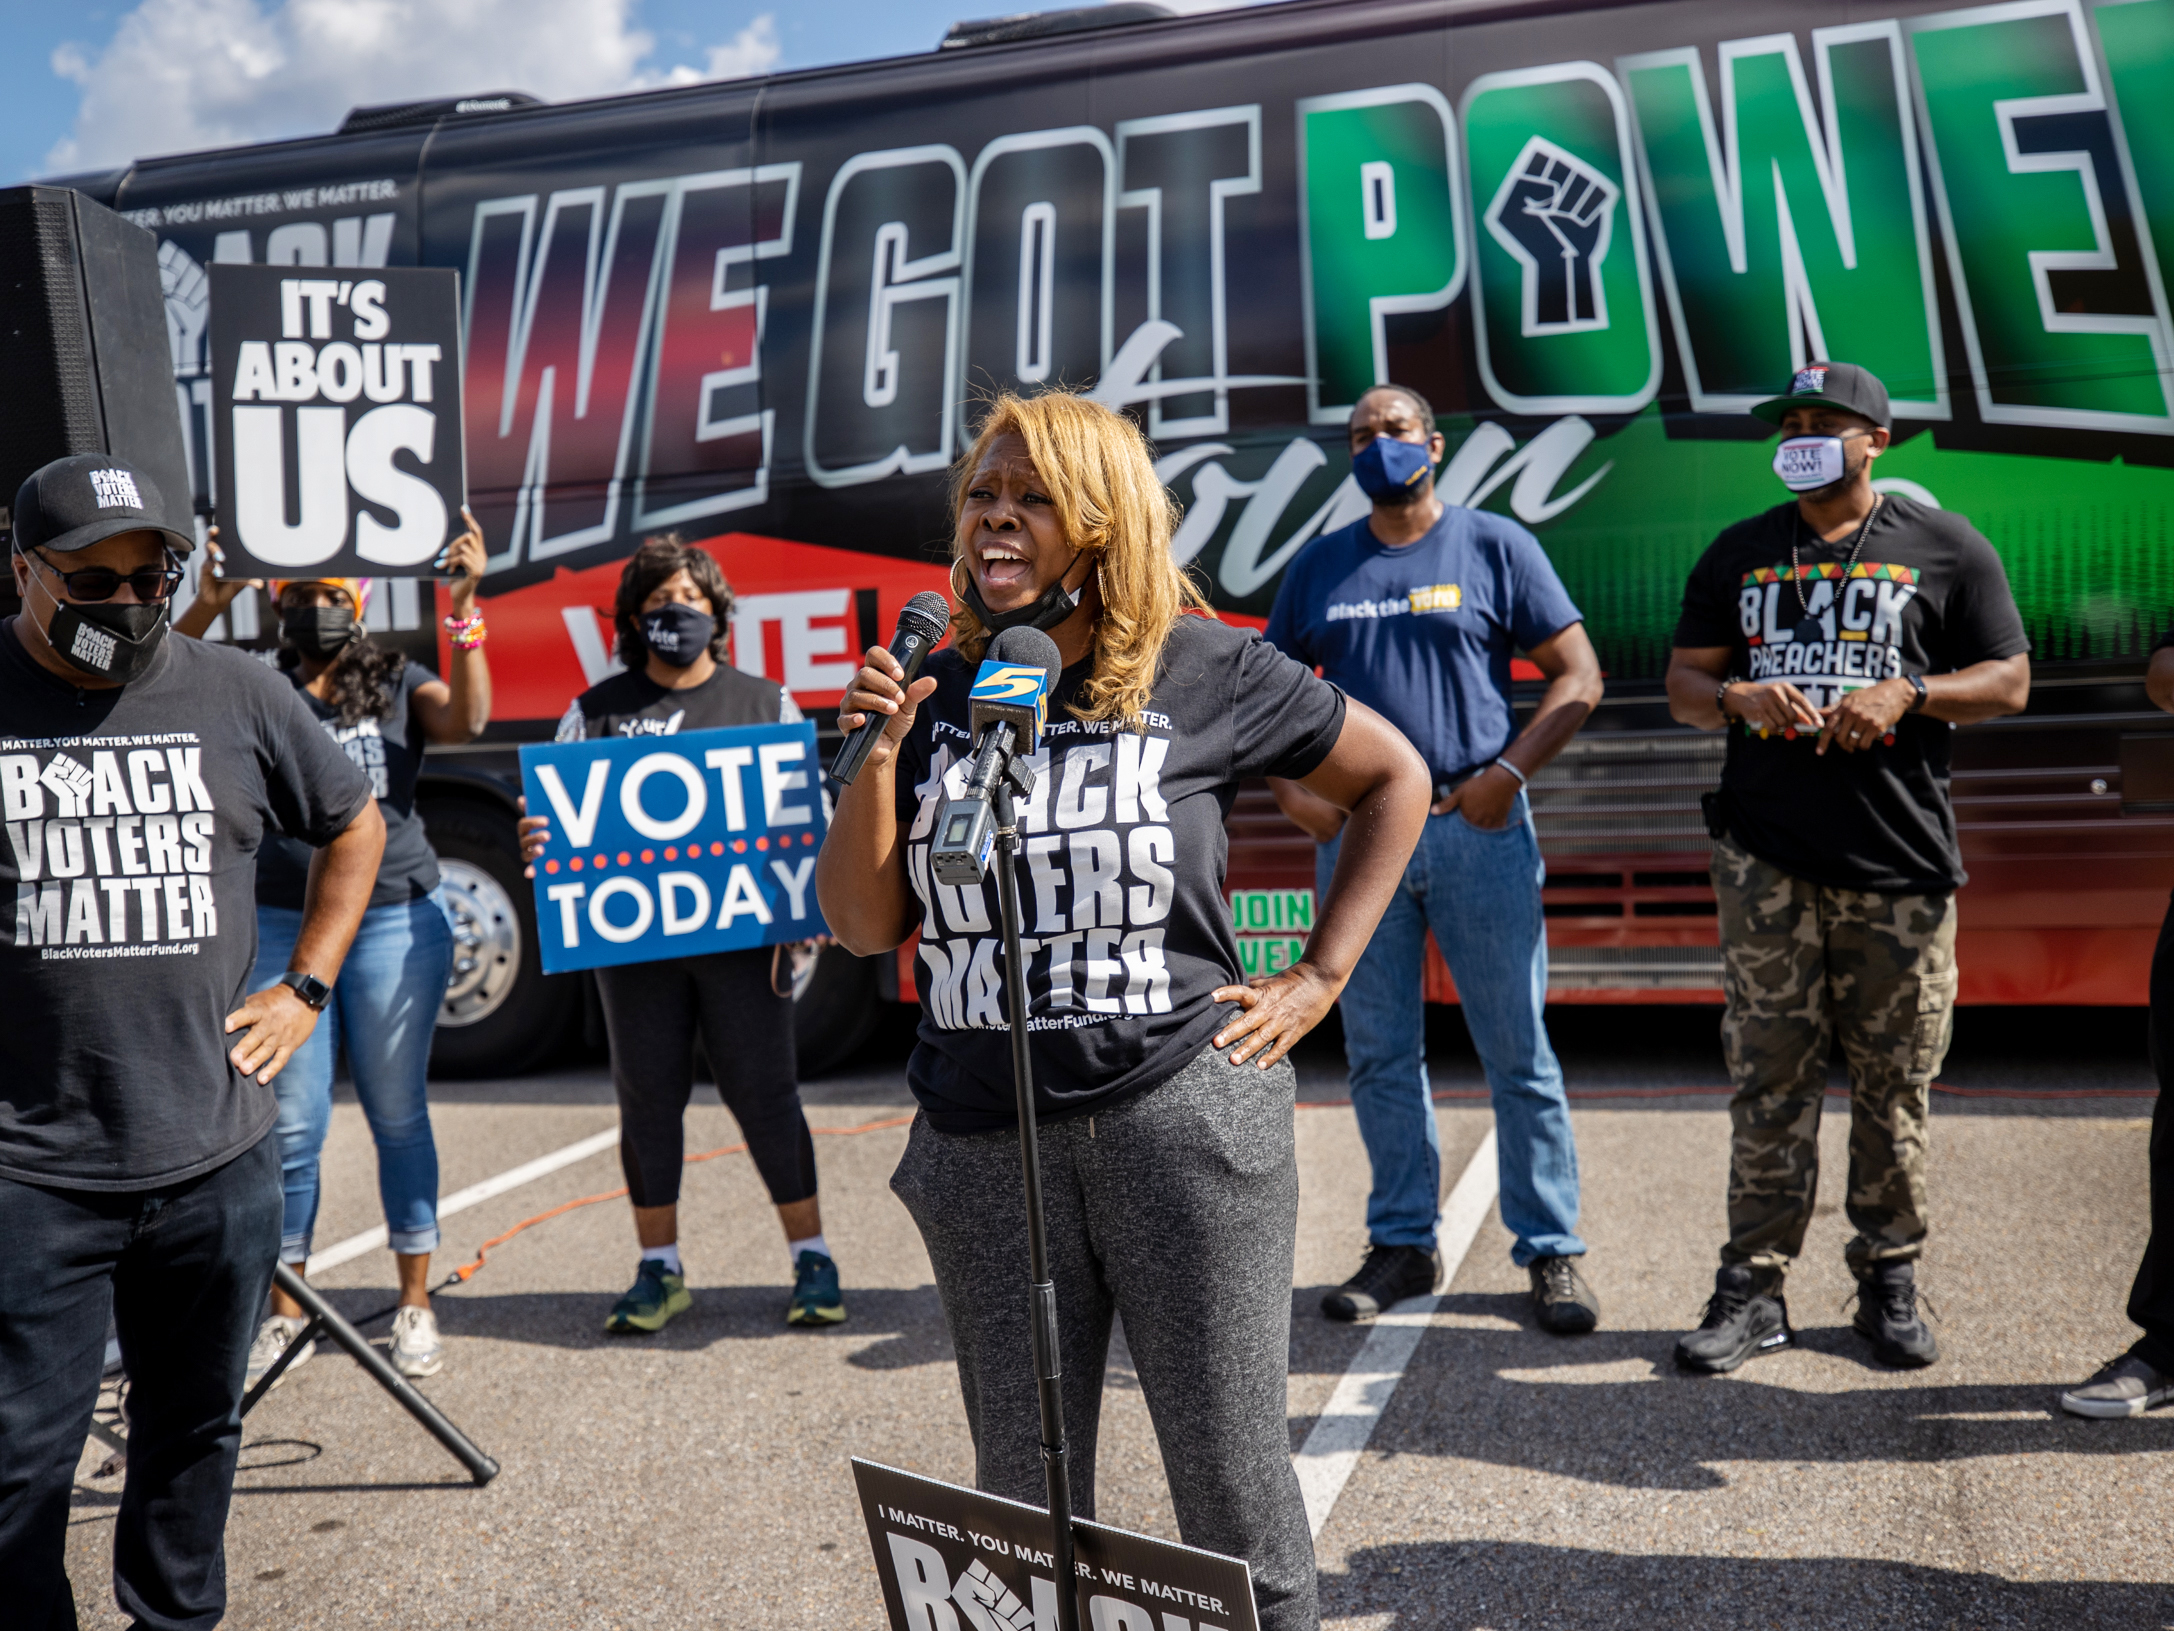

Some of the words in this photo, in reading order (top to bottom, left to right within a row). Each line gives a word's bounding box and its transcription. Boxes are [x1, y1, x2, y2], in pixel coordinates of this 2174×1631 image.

[282, 187, 317, 210] WE
[317, 178, 399, 207] MATTER.
[281, 278, 391, 341] IT'S
[463, 161, 803, 574] WE
[803, 103, 1263, 490] GOT
[232, 340, 442, 403] ABOUT
[97, 496, 143, 510] MATTER
[232, 403, 449, 567] US
[1739, 578, 1917, 646] BLACK
[70, 646, 111, 671] MATTER
[74, 635, 115, 660] VOTERS
[970, 668, 1047, 699] 5
[54, 736, 80, 748] YOU
[82, 735, 132, 747] MATTER.
[132, 735, 151, 745] WE
[152, 732, 200, 744] MATTER.
[1082, 719, 1109, 734] WE
[534, 741, 813, 849] VOTE
[5, 812, 215, 882] VOTERS
[15, 874, 218, 946] MATTER
[547, 857, 816, 948] TODAY
[1230, 889, 1315, 932] JOIN
[41, 943, 200, 960] BlackVotersMatterFund.org
[878, 1504, 885, 1518] I
[888, 1507, 965, 1542] MATTER.
[967, 1530, 1009, 1555] YOU
[1014, 1544, 1098, 1580] MATER.
[1100, 1567, 1136, 1591] WE
[1140, 1578, 1230, 1616] MATTER.
